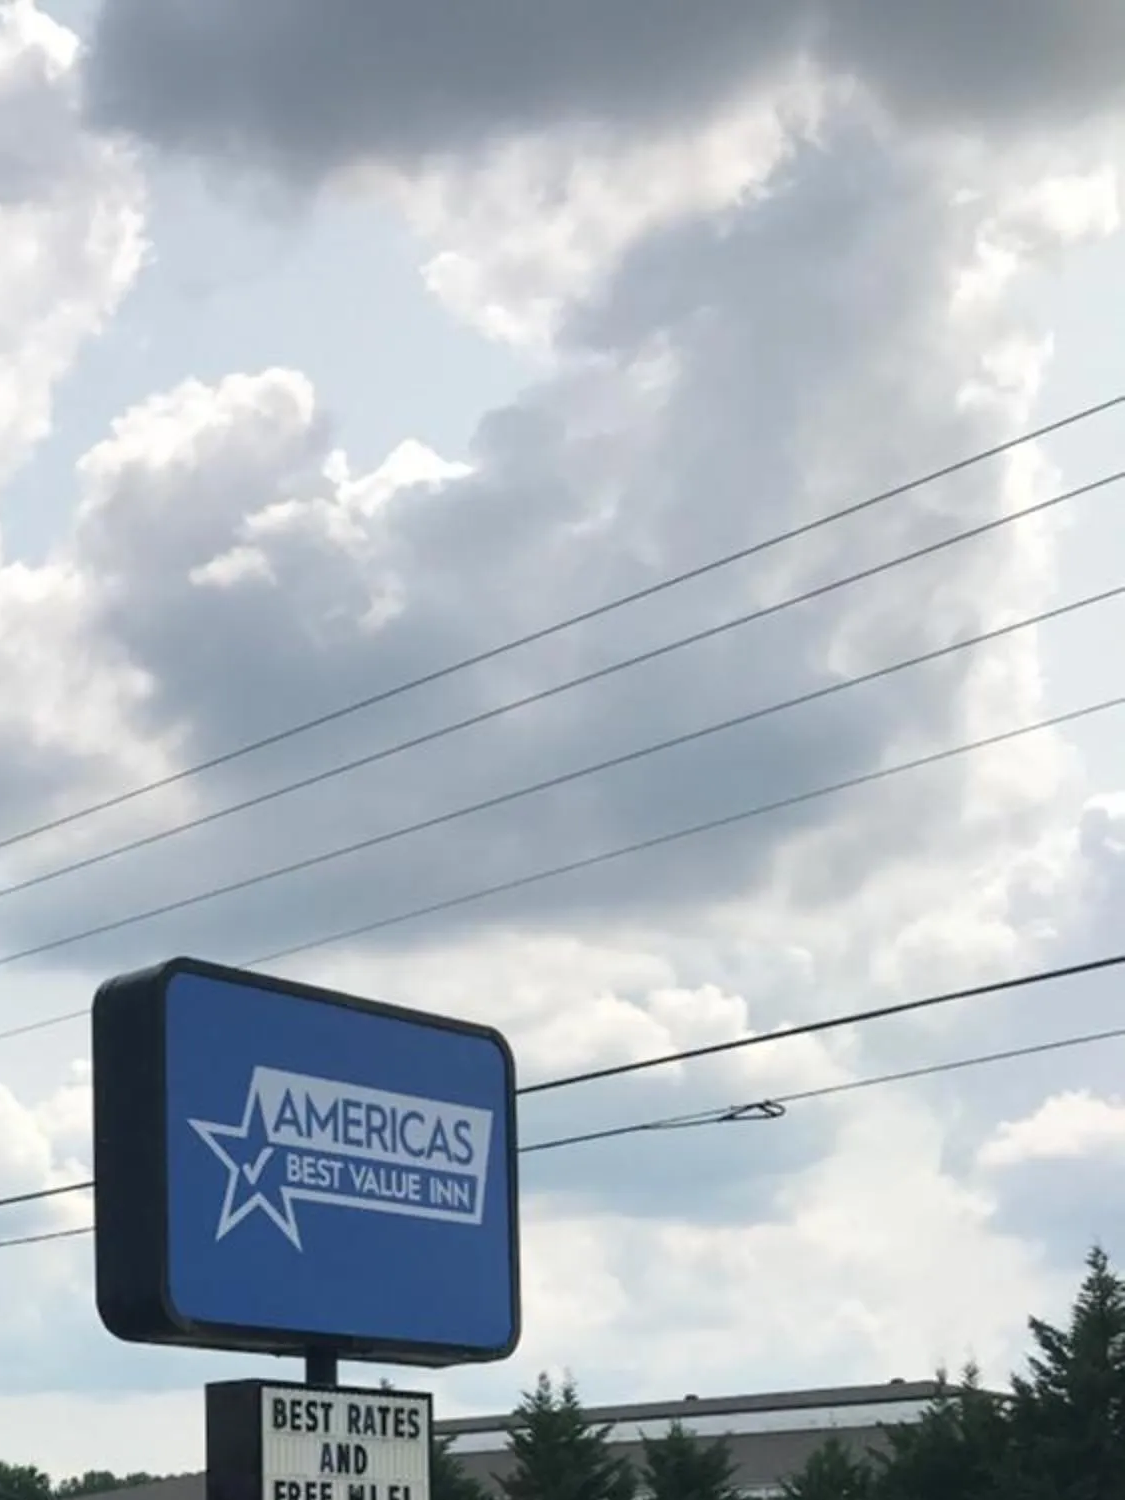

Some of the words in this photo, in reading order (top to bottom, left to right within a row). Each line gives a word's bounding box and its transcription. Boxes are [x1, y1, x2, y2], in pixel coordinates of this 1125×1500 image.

[272, 1087, 473, 1166] AMERICAS
[286, 1153, 344, 1189] BEST
[349, 1162, 421, 1200] VALUE
[429, 1177, 471, 1208] INN
[272, 1397, 334, 1433] BEST
[347, 1404, 420, 1439] RATES
[320, 1442, 368, 1475] AND
